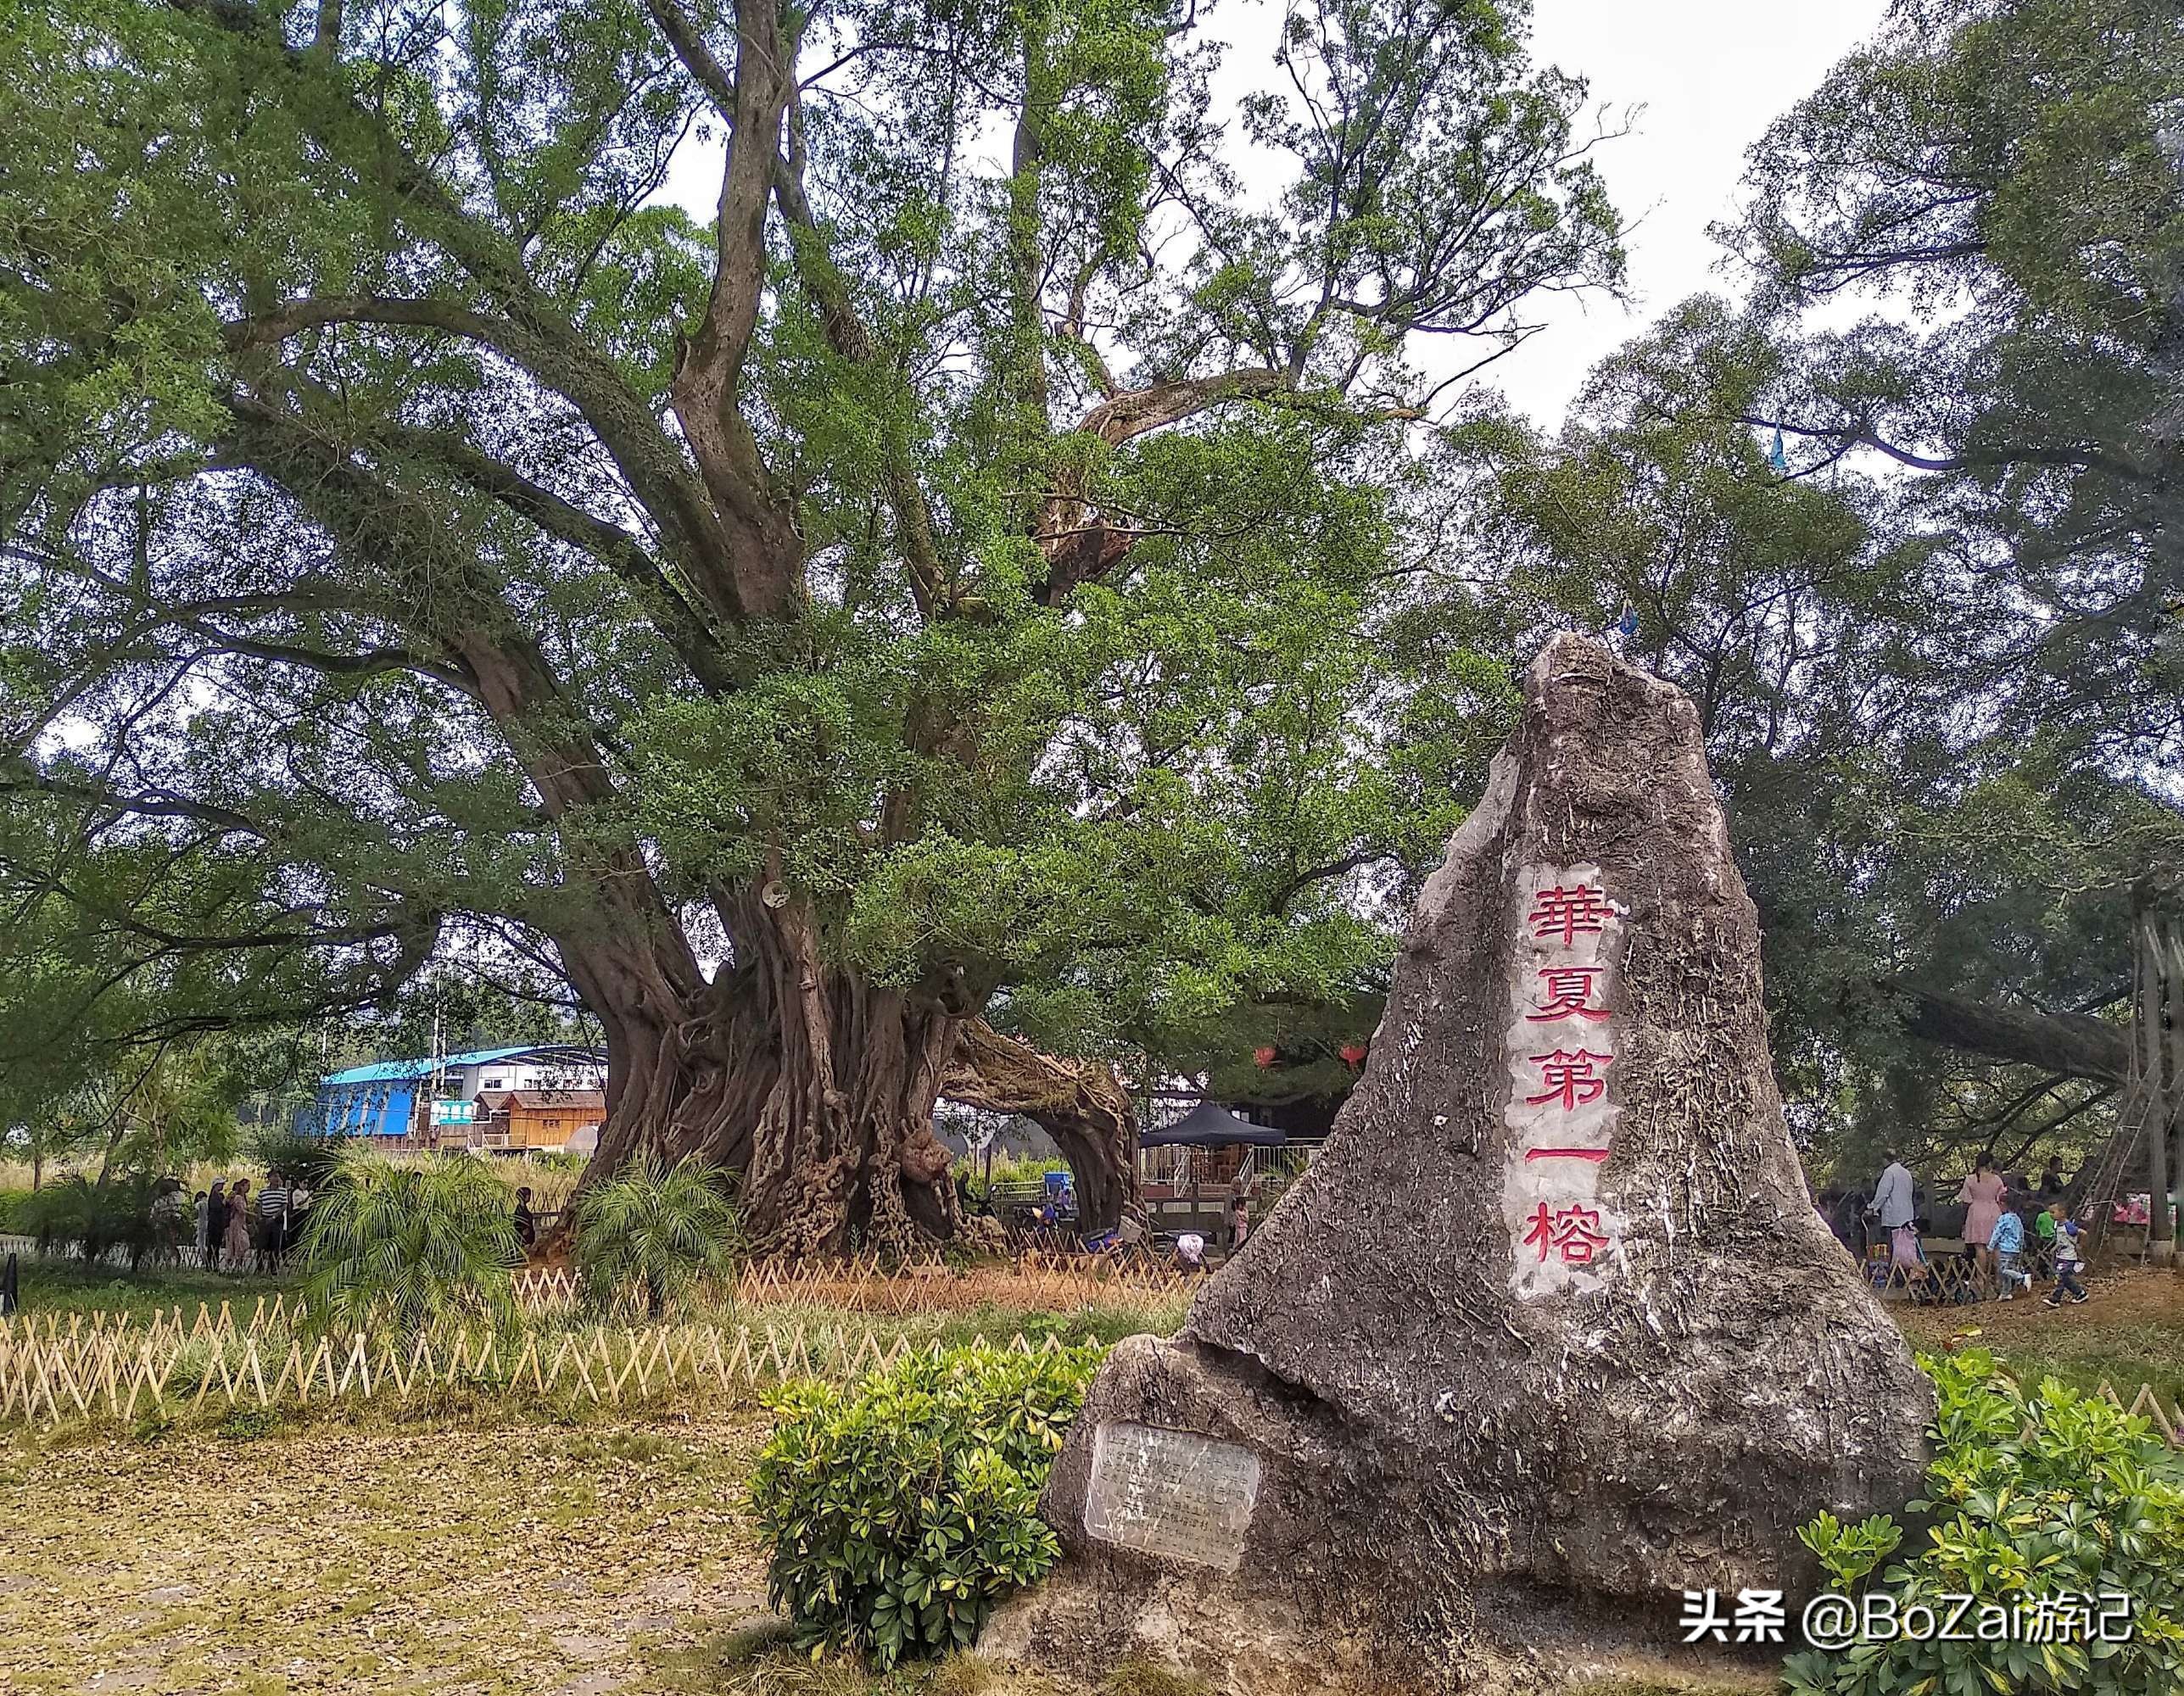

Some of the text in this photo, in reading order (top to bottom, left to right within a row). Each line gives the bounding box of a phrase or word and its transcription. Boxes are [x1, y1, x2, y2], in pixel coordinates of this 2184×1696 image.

[1524, 884, 1614, 1263] 華夏第一榕
